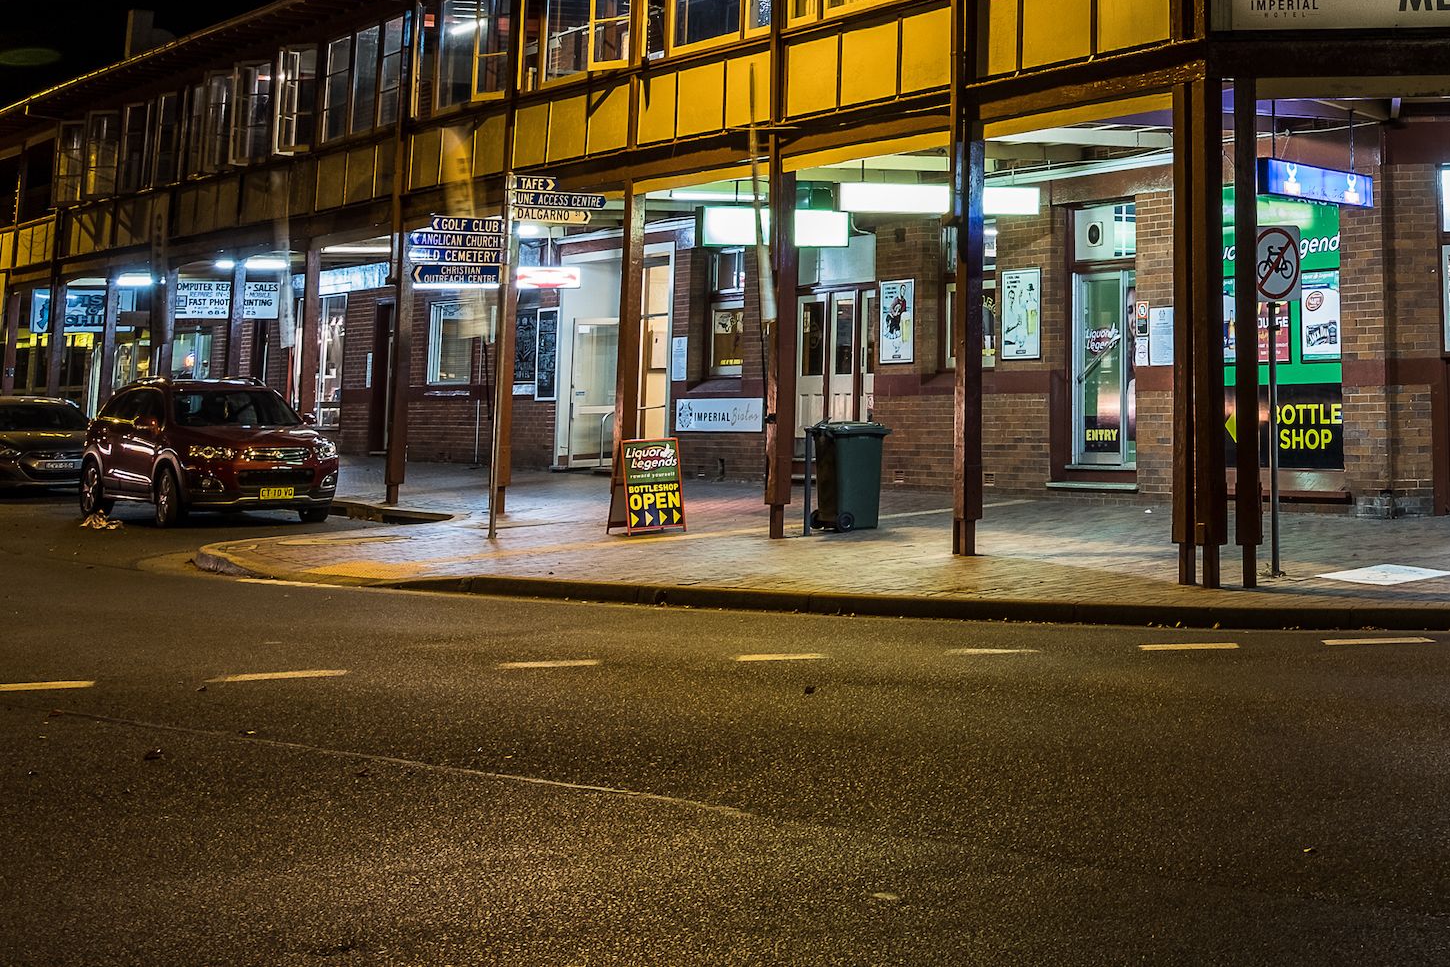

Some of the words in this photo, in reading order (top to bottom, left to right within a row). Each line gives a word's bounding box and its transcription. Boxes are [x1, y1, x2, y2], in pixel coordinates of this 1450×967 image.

[1251, 0, 1319, 11] IMPERIAL
[521, 178, 544, 190] TAFE
[517, 193, 535, 205] UNE
[538, 195, 569, 206] ACCESS
[571, 196, 602, 207] CENTRE
[517, 207, 570, 221] DALGARNO
[441, 220, 467, 230] GOLF
[472, 221, 499, 232] CLUB
[421, 233, 462, 246] ANGLICAN
[466, 235, 499, 248] CHURCH
[444, 250, 497, 263] CEMETERY
[441, 266, 481, 275] CHRISTIAN
[424, 275, 464, 283] OUTREACH
[467, 275, 497, 283] CENTRE
[253, 283, 278, 292] SALES
[188, 298, 207, 306] FAST
[209, 298, 231, 306] PHOT
[243, 298, 272, 306] RINTING
[1086, 328, 1110, 342] Liquor
[694, 412, 730, 422] IMPERIAL
[1085, 429, 1118, 441] ENTRY
[1280, 429, 1333, 450] SHOP
[625, 447, 661, 460] Liquor
[631, 456, 678, 471] Legends
[628, 483, 679, 494] BOTTLESHOP
[629, 491, 681, 511] OPEN
